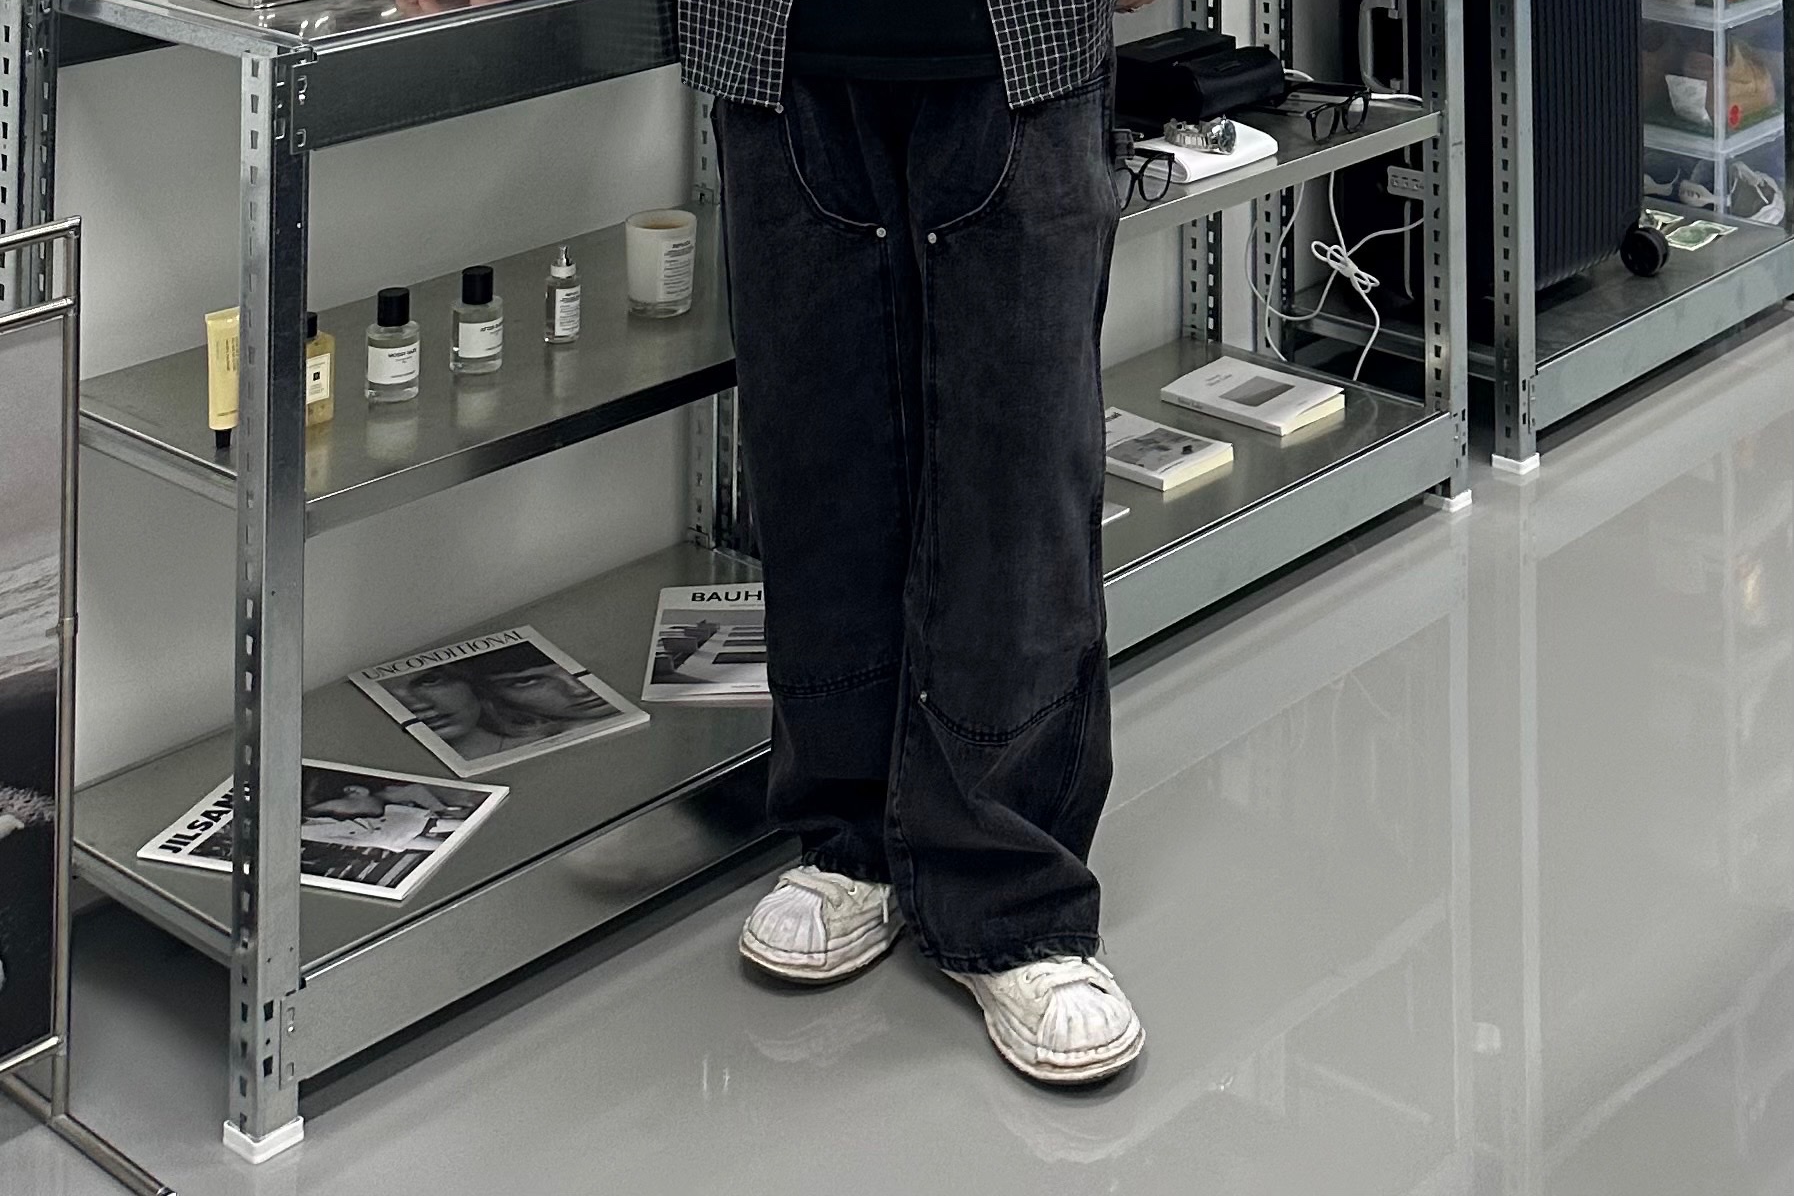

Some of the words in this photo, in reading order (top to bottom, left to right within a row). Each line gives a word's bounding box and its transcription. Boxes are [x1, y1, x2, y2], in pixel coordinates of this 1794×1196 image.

[691, 590, 762, 602] BAUH
[362, 630, 525, 680] UNCONDITIONAL
[158, 787, 234, 854] JILSAN
